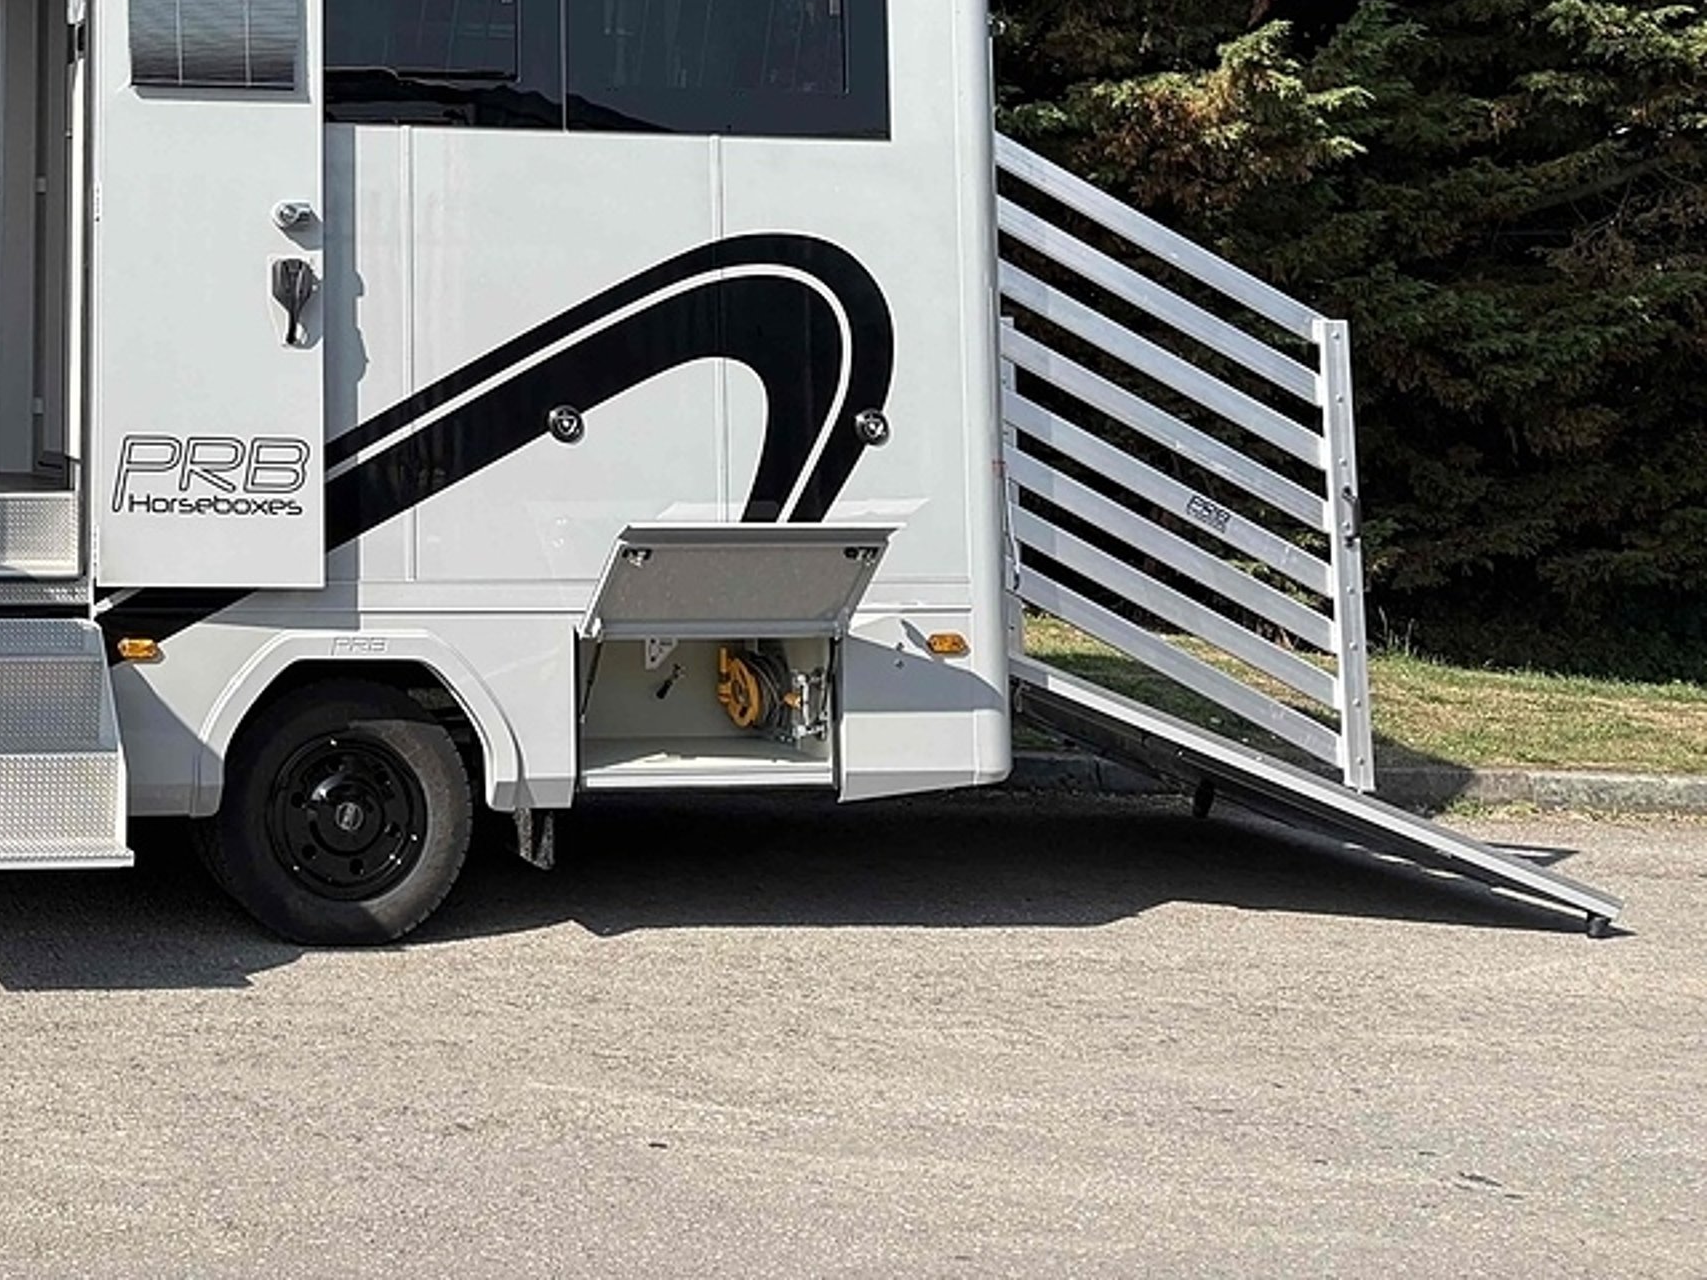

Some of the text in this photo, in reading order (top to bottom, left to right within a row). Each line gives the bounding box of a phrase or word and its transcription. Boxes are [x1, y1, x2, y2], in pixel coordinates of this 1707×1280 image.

[112, 434, 310, 512] PRB
[128, 494, 303, 516] Horseboxes
[330, 636, 387, 656] PRB
